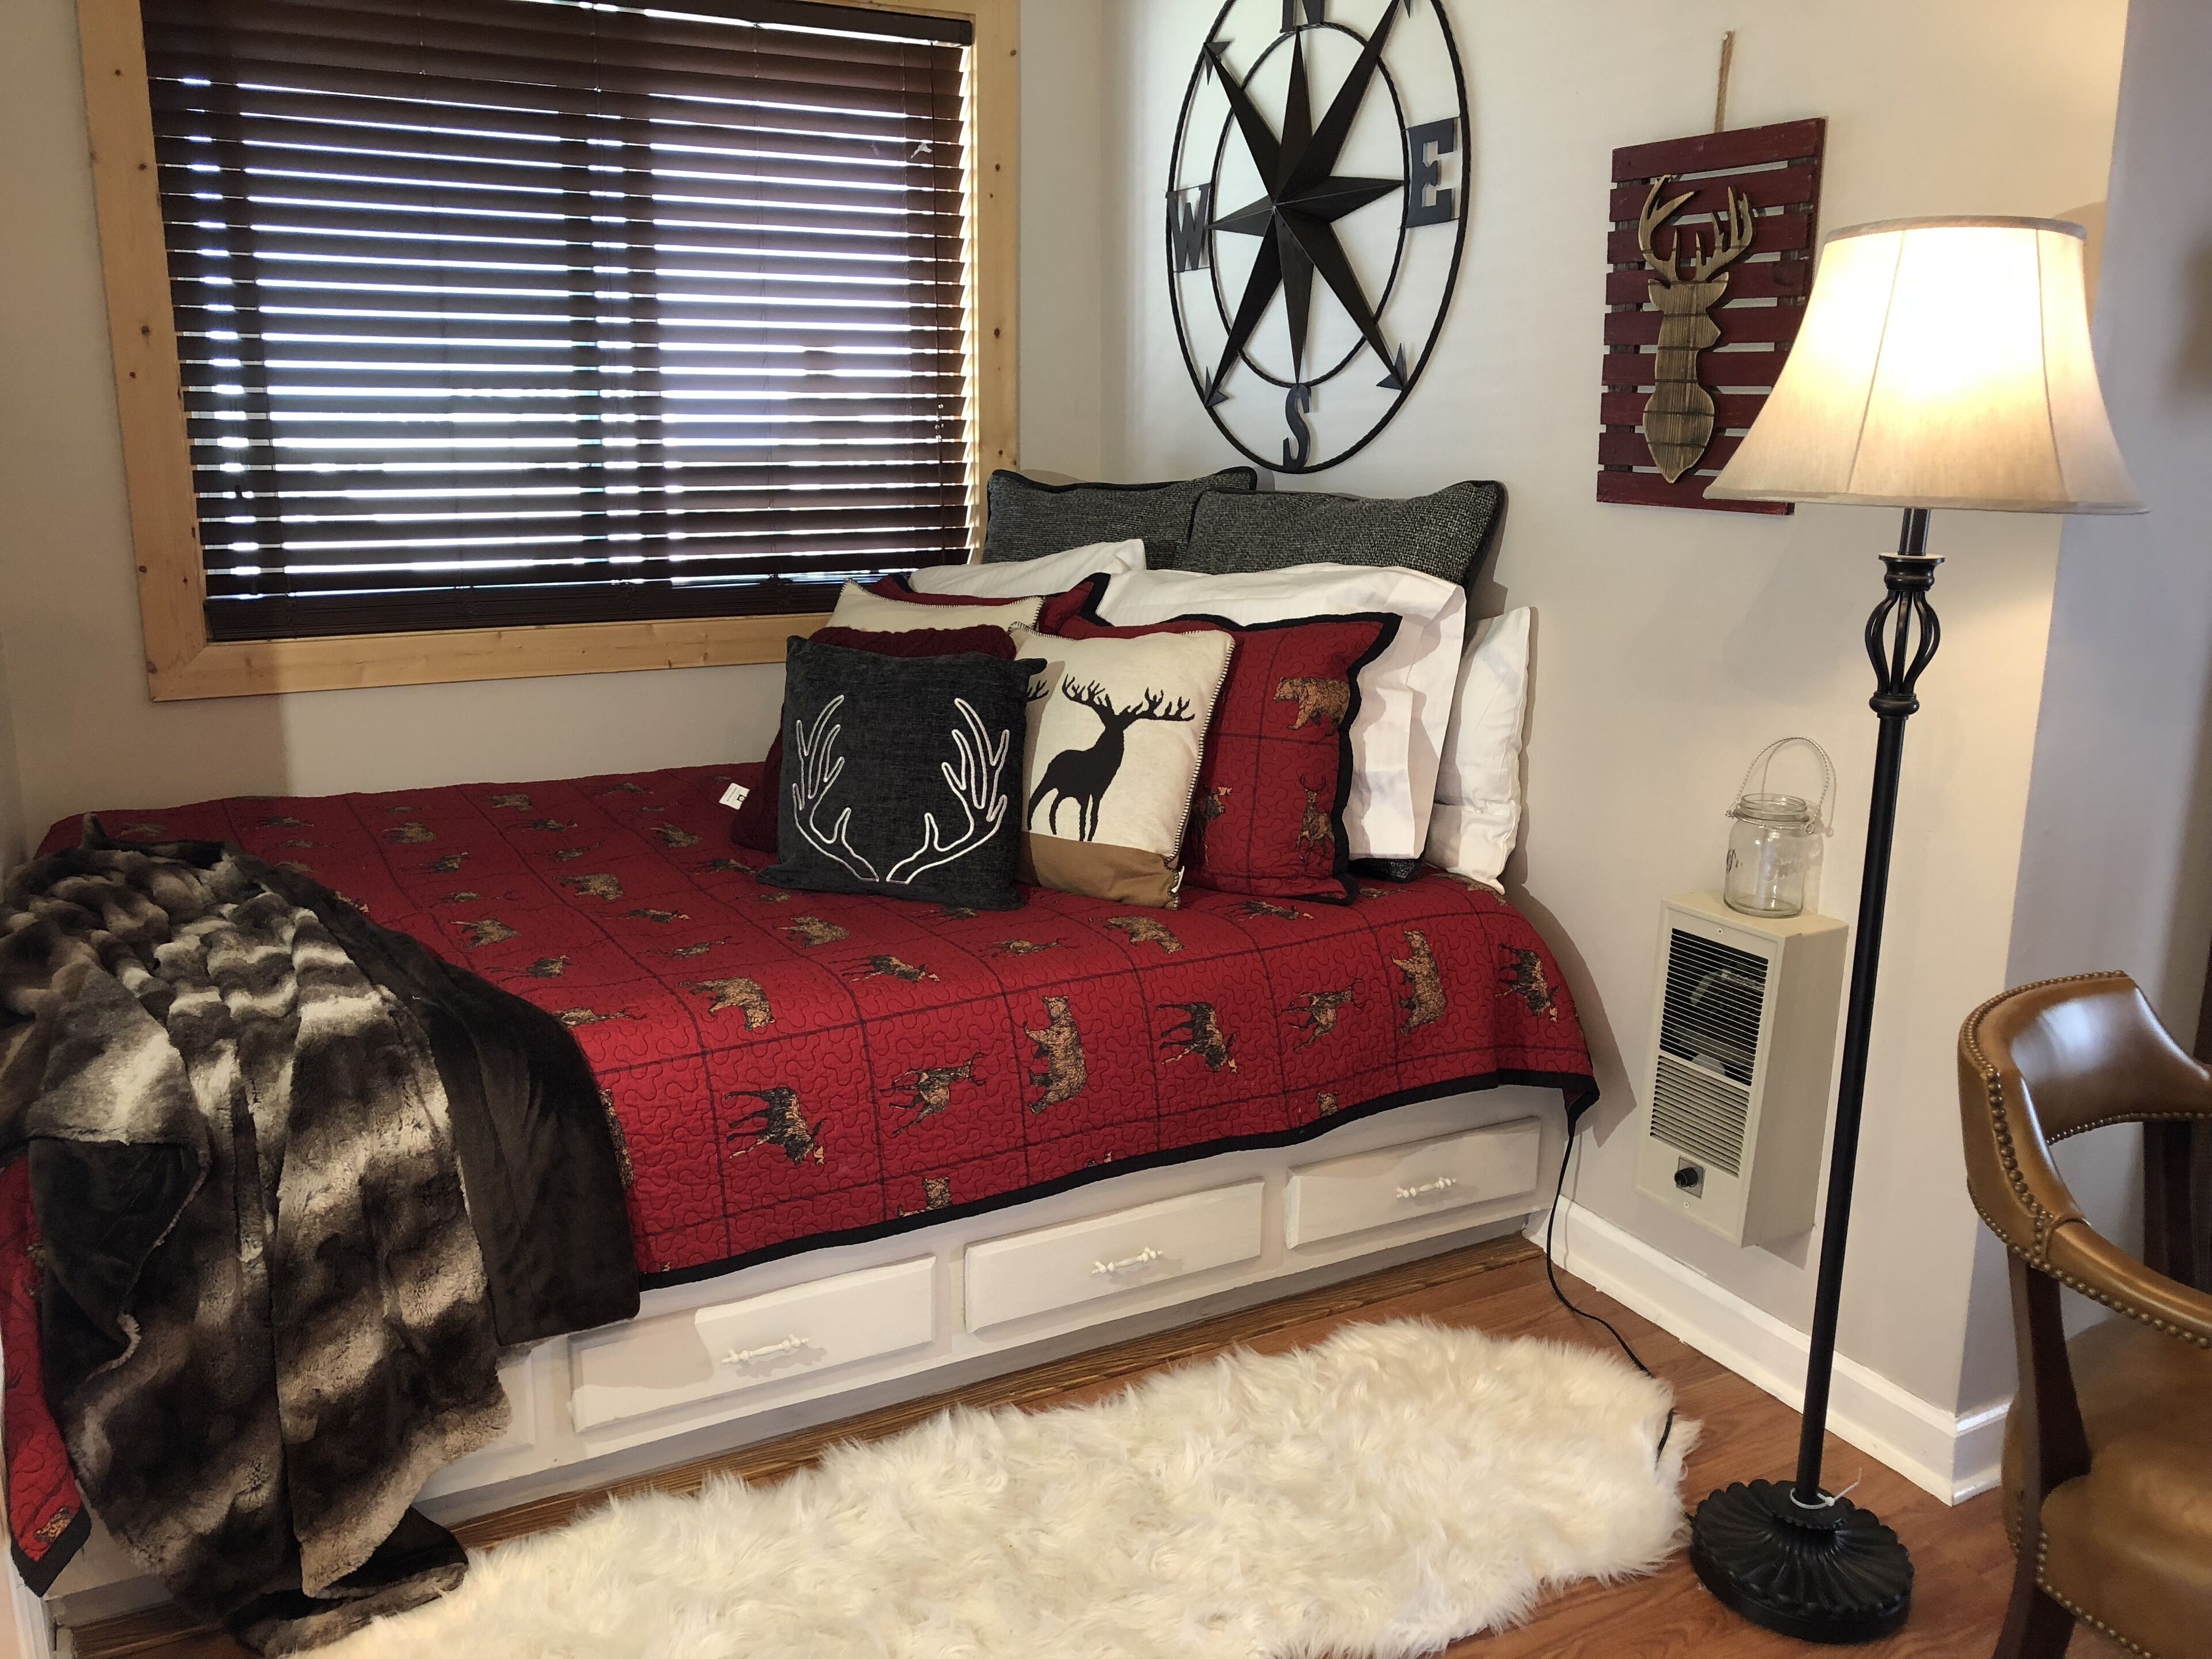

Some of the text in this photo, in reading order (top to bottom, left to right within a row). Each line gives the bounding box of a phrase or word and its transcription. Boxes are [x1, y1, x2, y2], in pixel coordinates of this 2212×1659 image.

[1404, 119, 1455, 229] E
[1165, 183, 1211, 273] W
[1283, 384, 1311, 471] S
